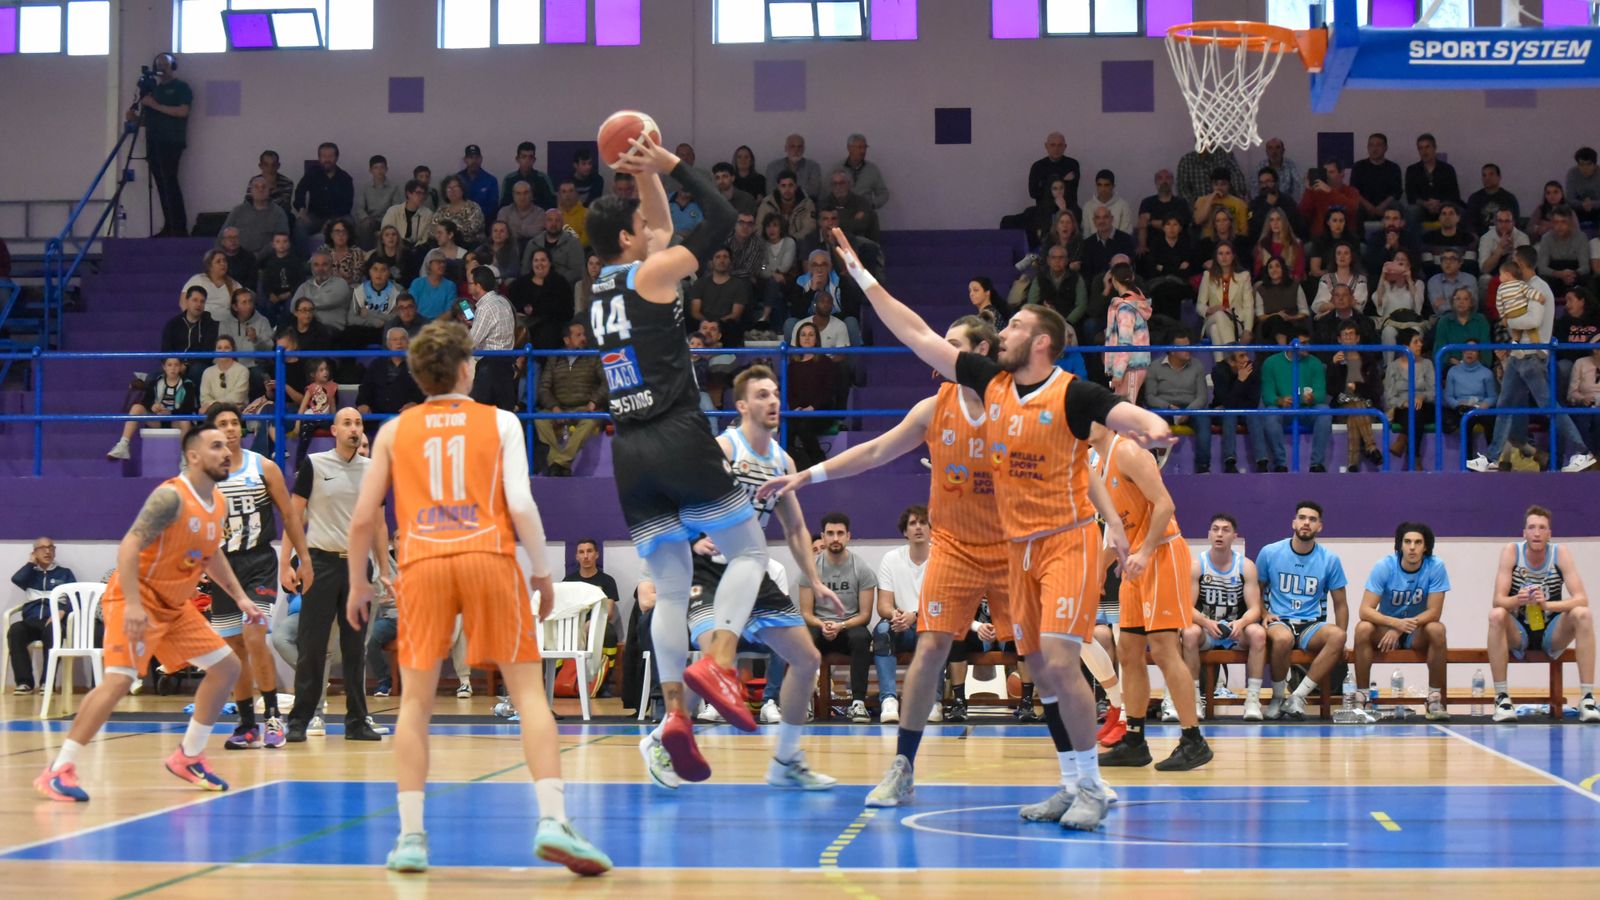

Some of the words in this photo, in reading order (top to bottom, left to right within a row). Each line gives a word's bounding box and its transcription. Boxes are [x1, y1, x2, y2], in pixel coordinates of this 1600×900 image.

[1409, 40, 1490, 58] SPORT
[1491, 40, 1592, 62] SYSTEM
[590, 294, 632, 345] 44
[425, 412, 467, 428] VICTOR
[1008, 415, 1024, 437] 21
[968, 437, 984, 458] 12
[1009, 451, 1046, 462] MELILLA
[423, 434, 466, 501] 11
[1009, 460, 1038, 469] SPORT
[973, 479, 994, 487] SPO
[1009, 469, 1044, 481] CAPITAL
[227, 496, 256, 516] LB
[1278, 572, 1319, 597] ULB
[1204, 588, 1238, 607] ULB
[1290, 600, 1302, 611] 10
[1391, 587, 1424, 607] ULB
[1055, 597, 1074, 619] 21
